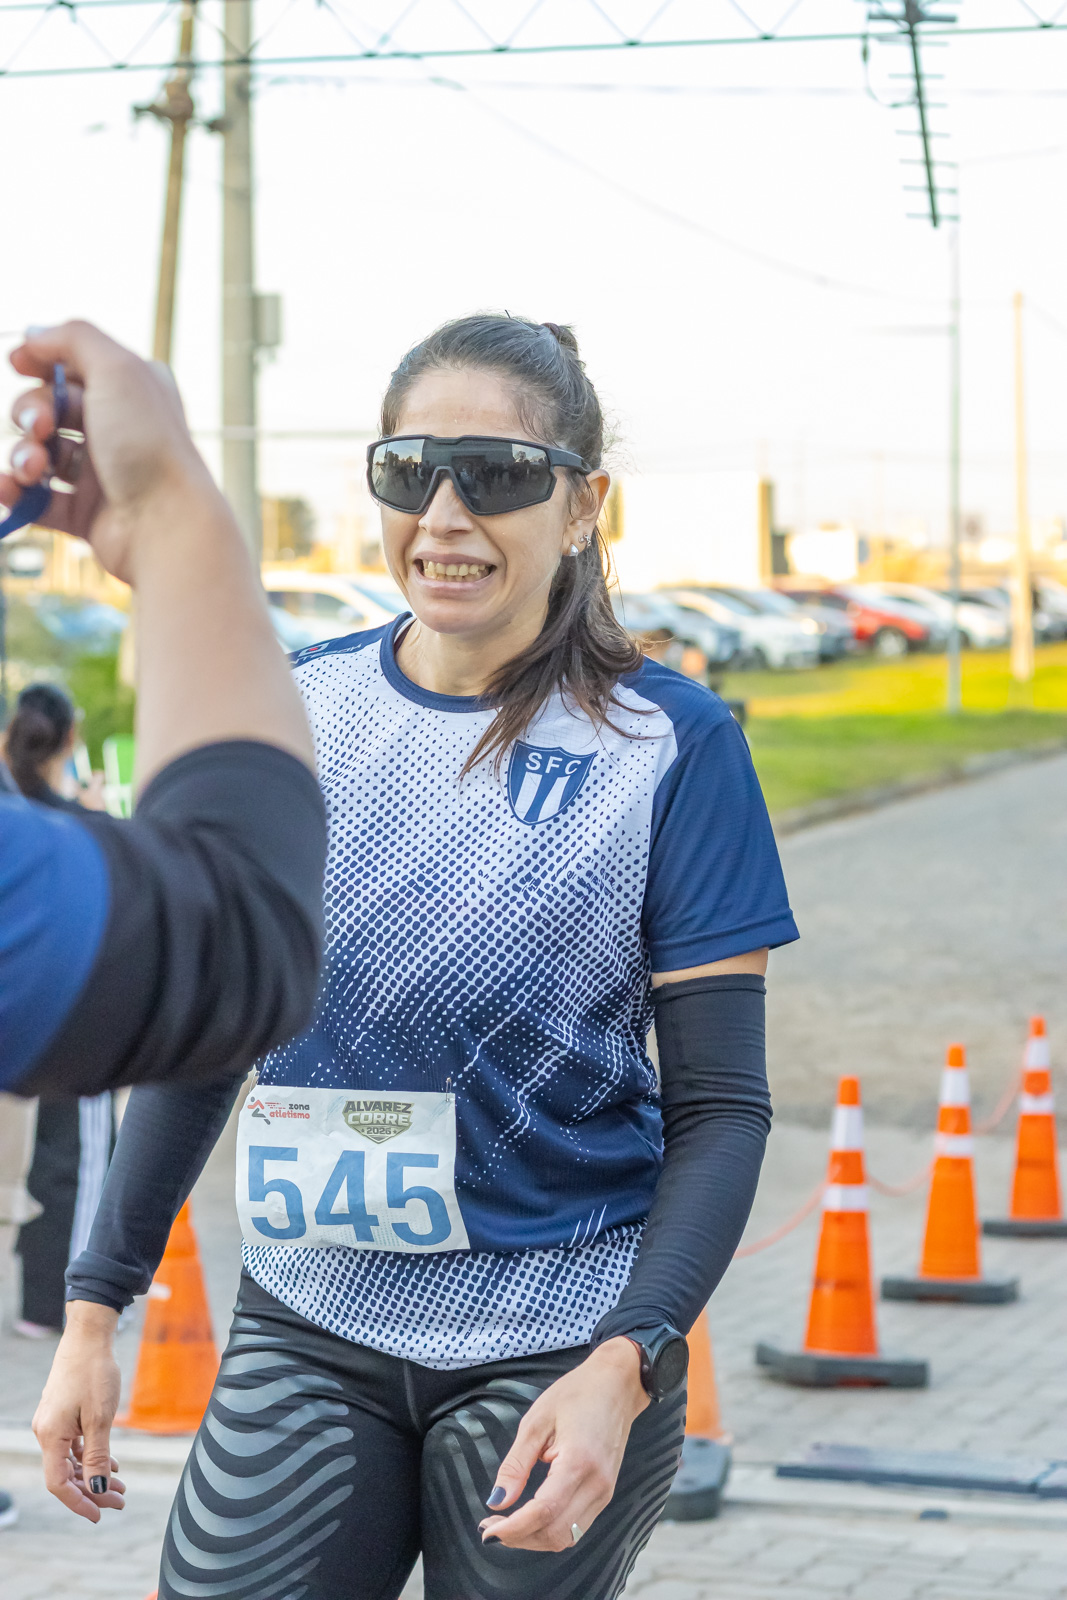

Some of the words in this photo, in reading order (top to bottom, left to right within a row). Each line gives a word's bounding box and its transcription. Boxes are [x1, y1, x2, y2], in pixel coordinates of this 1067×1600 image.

[525, 752, 582, 775] SFC
[288, 1103, 310, 1111] zona
[344, 1100, 412, 1114] ALVAREZ
[269, 1110, 311, 1119] atletismo
[347, 1112, 410, 1127] CORRE
[366, 1127, 392, 1135] 2026
[248, 1145, 452, 1246] 545
